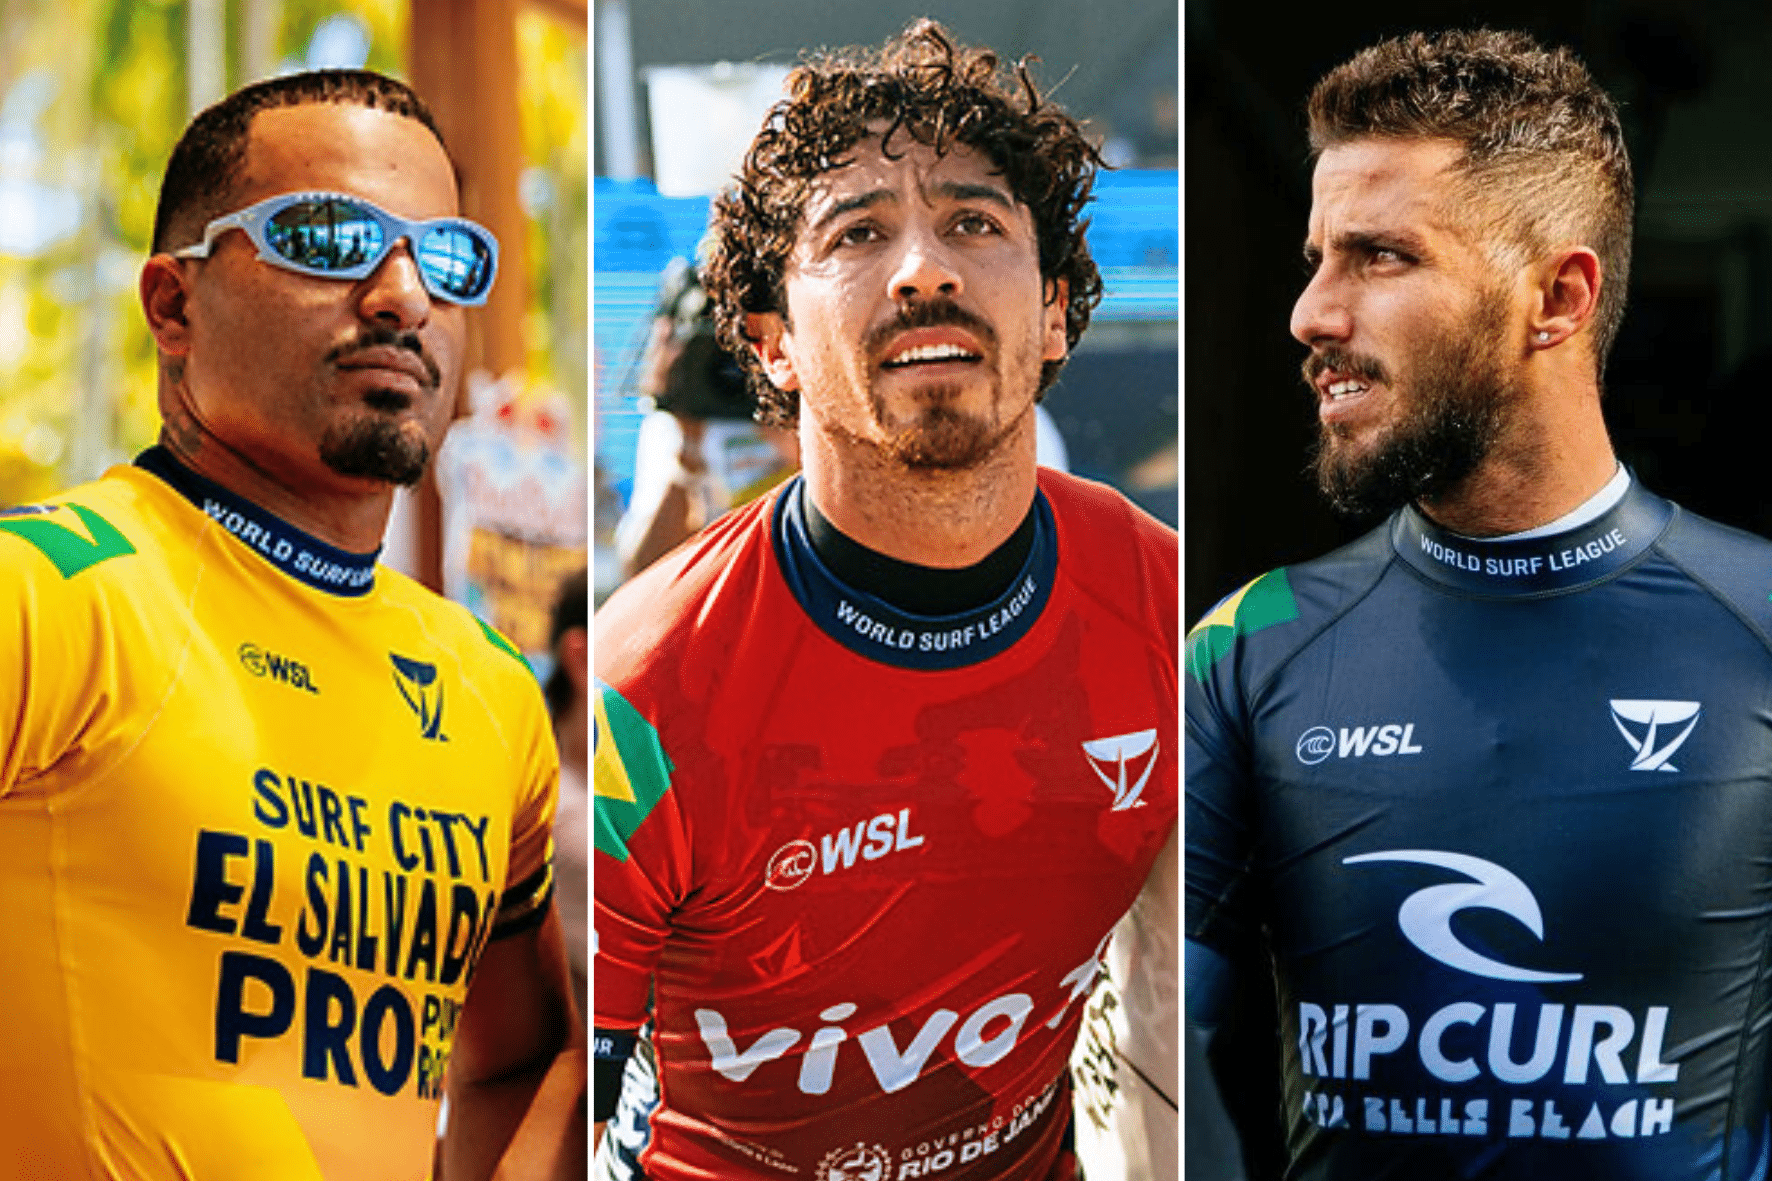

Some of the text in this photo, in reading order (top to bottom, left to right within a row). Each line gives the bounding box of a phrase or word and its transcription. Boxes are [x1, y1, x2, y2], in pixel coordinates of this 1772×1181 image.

[203, 498, 293, 562] WORLD
[1421, 527, 1627, 577] WORLD SURF LEAGUE
[837, 574, 1037, 651] WORLD SURF LEAGUE
[265, 652, 320, 695] WSL
[1338, 723, 1422, 758] WSL
[252, 768, 372, 852] SURF
[821, 807, 924, 876] WSL
[187, 830, 282, 944] EL
[215, 951, 416, 1097] PRO
[695, 993, 1034, 1095] vivo
[1418, 1002, 1680, 1085] CURL
[1363, 1097, 1489, 1136] BELLS
[1508, 1098, 1674, 1140] BEACH
[896, 1150, 955, 1181] RIO
[959, 1130, 1000, 1164] DE
